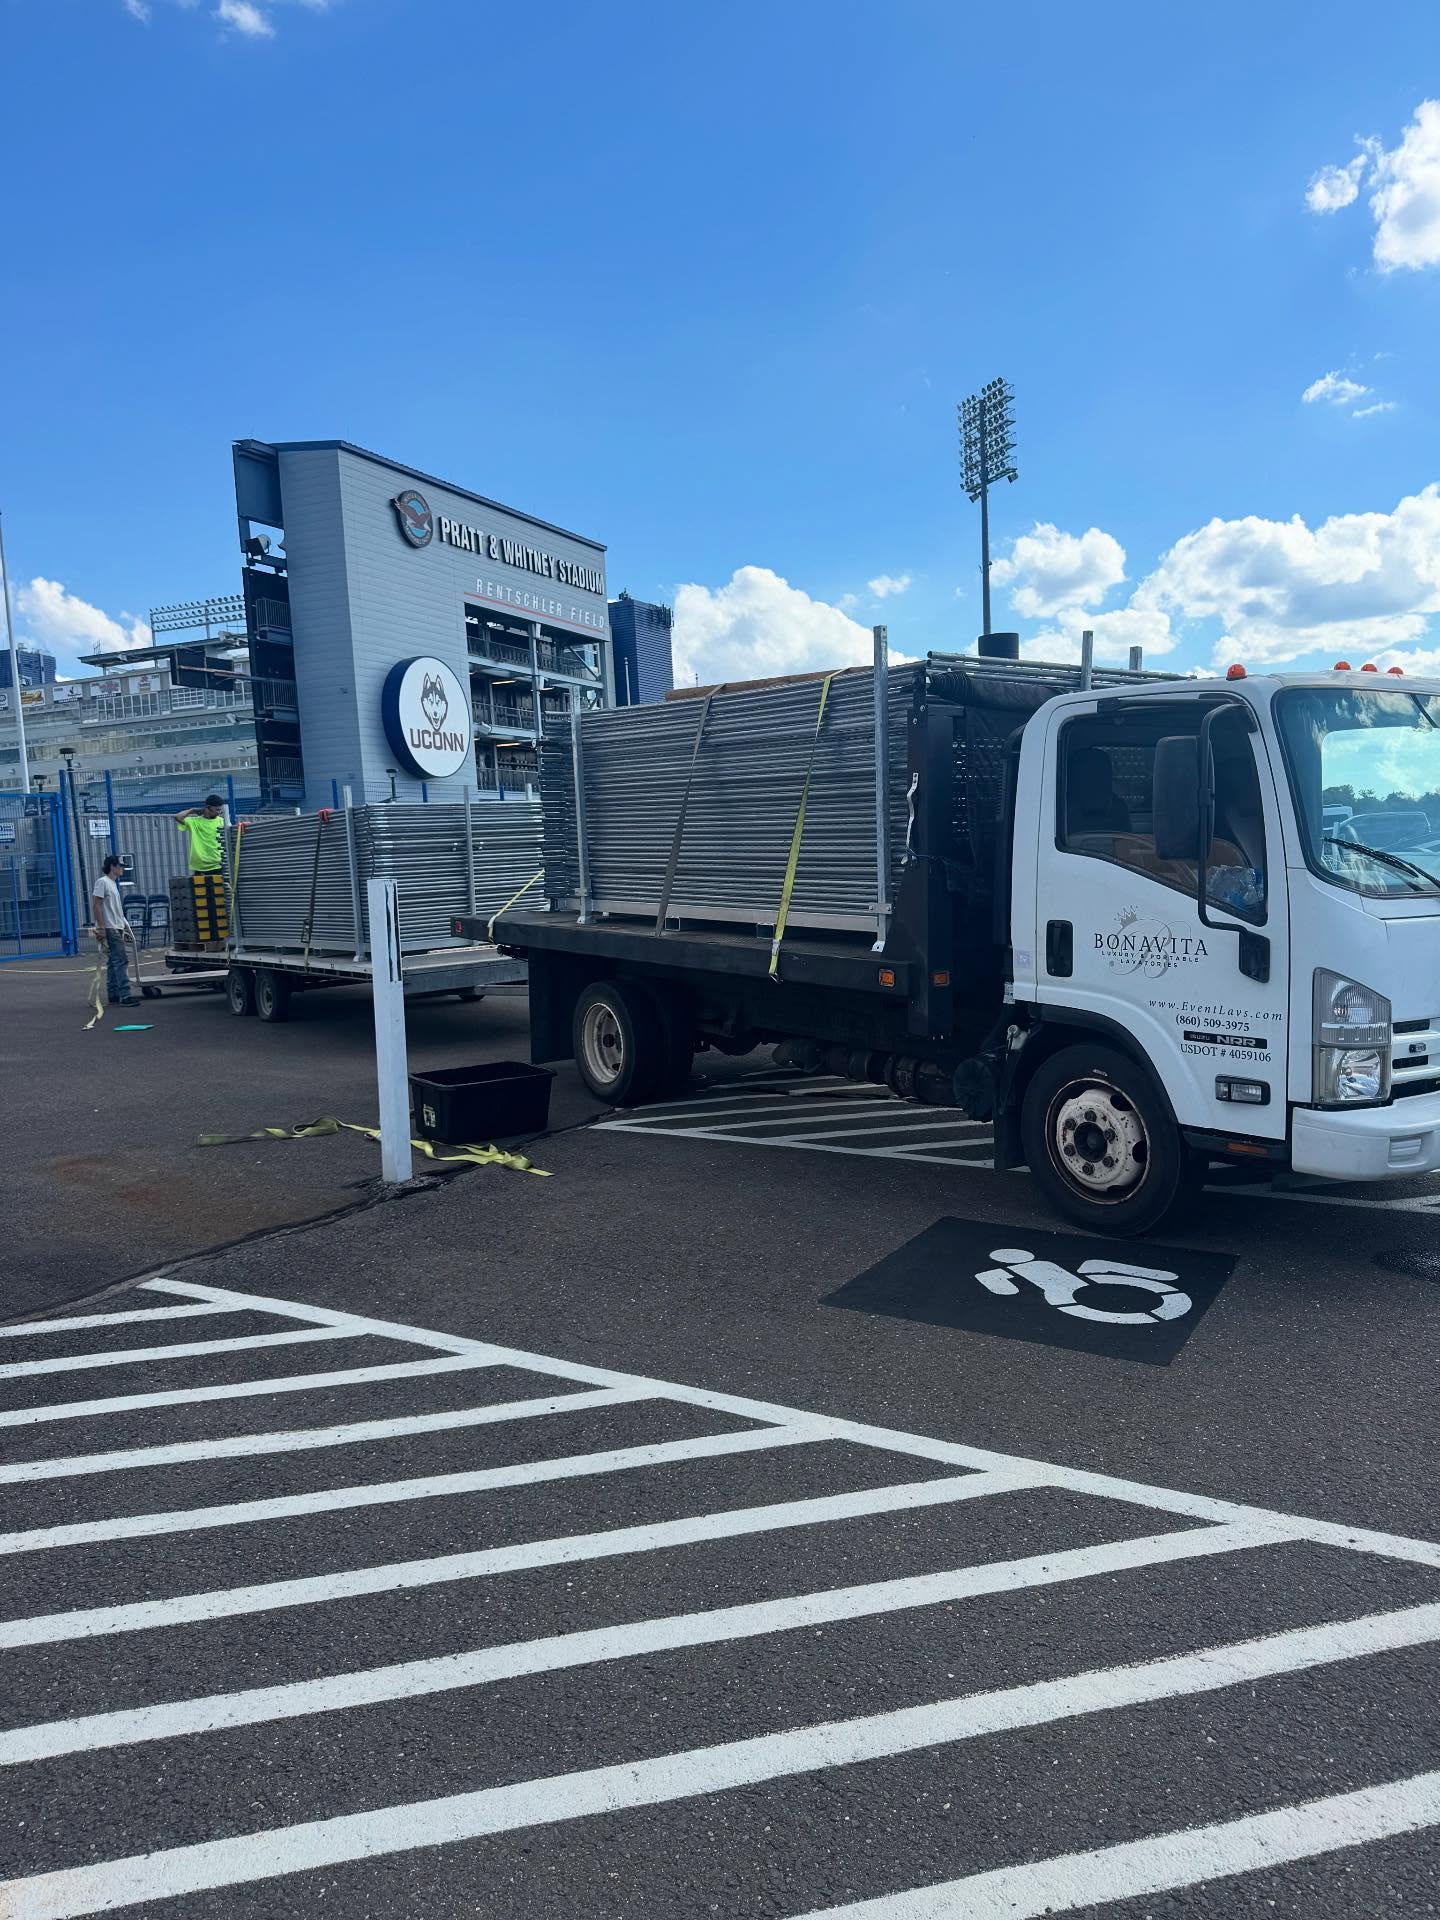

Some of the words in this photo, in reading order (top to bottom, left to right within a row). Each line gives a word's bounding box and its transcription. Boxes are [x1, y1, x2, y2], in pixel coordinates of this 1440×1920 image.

[439, 516, 485, 555] PRATT
[488, 534, 500, 560] &
[500, 538, 555, 578] WHITNEY
[557, 559, 605, 596] STADIUM
[476, 578, 563, 617] RENTSCHLER
[570, 607, 605, 629] FIELD
[409, 727, 465, 753] UCONN
[1094, 932, 1208, 956] BONAVITA
[1101, 950, 1136, 958] LUXURY
[1150, 953, 1200, 963] PORTABLE
[1120, 958, 1179, 968] LAVATORIES
[1148, 1000, 1283, 1021] www.EventLavs.com
[1175, 1013, 1201, 1028] (860)
[1203, 1017, 1250, 1032] 509-3975
[1216, 1035, 1257, 1048] NRR
[1179, 1043, 1219, 1057] USDOT
[1220, 1048, 1227, 1058] #
[1228, 1048, 1272, 1063] 4059106
